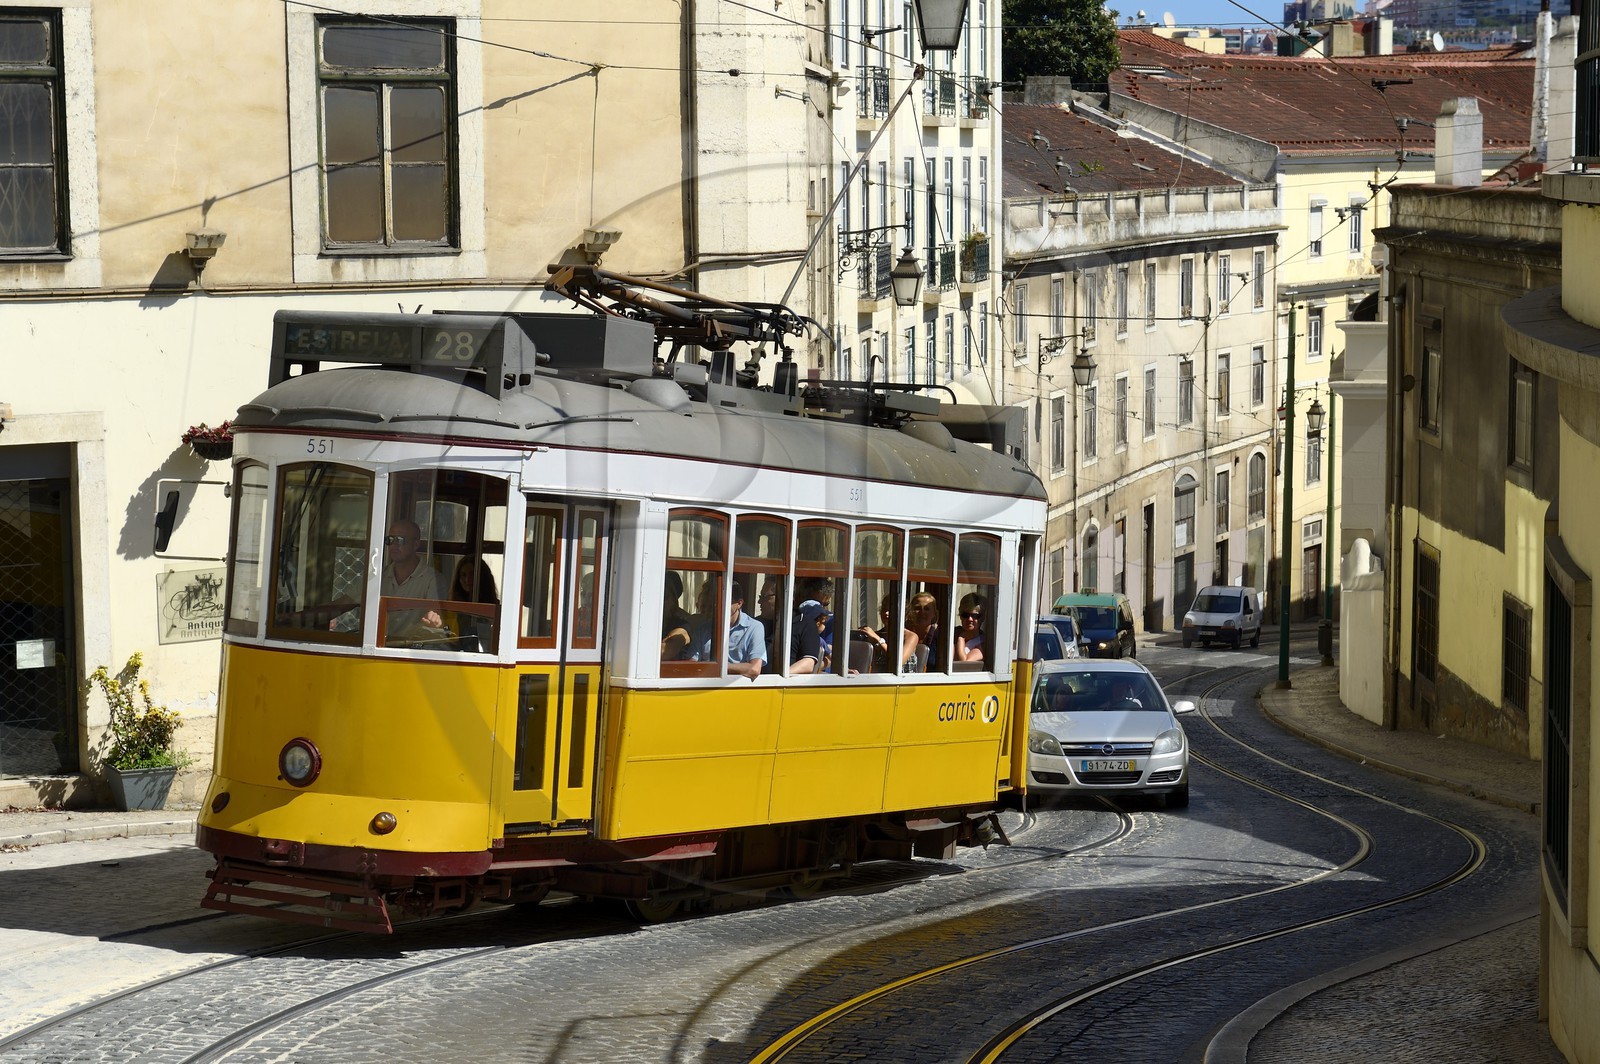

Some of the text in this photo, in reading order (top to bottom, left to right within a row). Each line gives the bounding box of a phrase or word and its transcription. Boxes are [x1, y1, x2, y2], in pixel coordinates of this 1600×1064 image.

[434, 331, 475, 361] 28
[306, 438, 334, 454] 551
[849, 488, 863, 501] 551
[938, 694, 976, 722] carris
